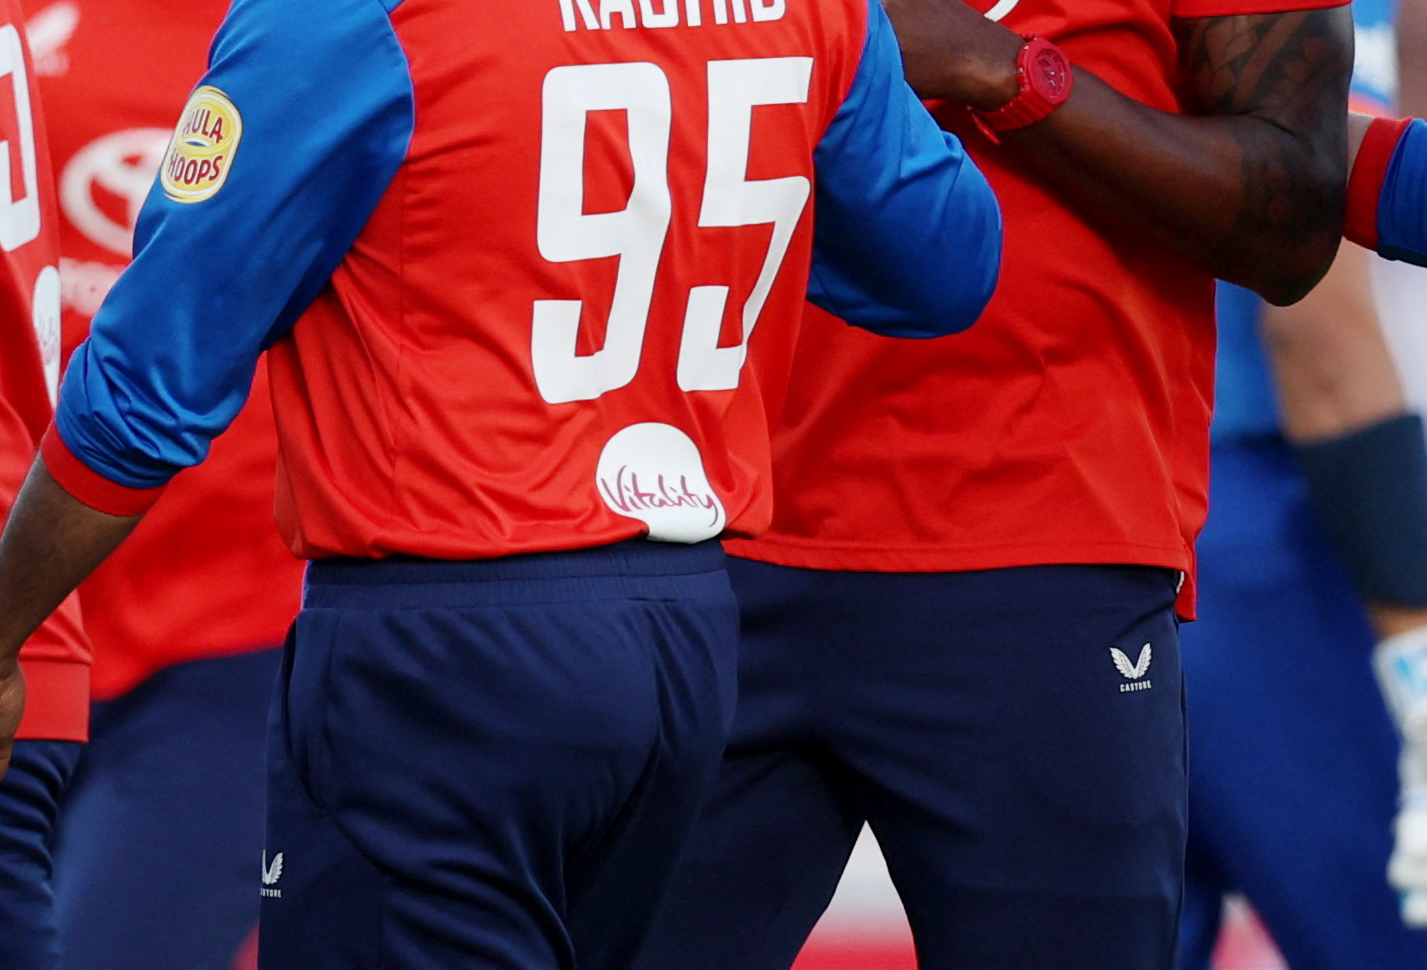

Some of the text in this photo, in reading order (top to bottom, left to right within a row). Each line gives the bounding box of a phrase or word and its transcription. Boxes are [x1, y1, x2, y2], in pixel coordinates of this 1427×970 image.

[183, 109, 224, 144] HULA
[168, 149, 223, 185] HOOPS
[531, 57, 814, 404] 95
[600, 465, 718, 528] Vitality
[1120, 680, 1152, 692] CASTORE
